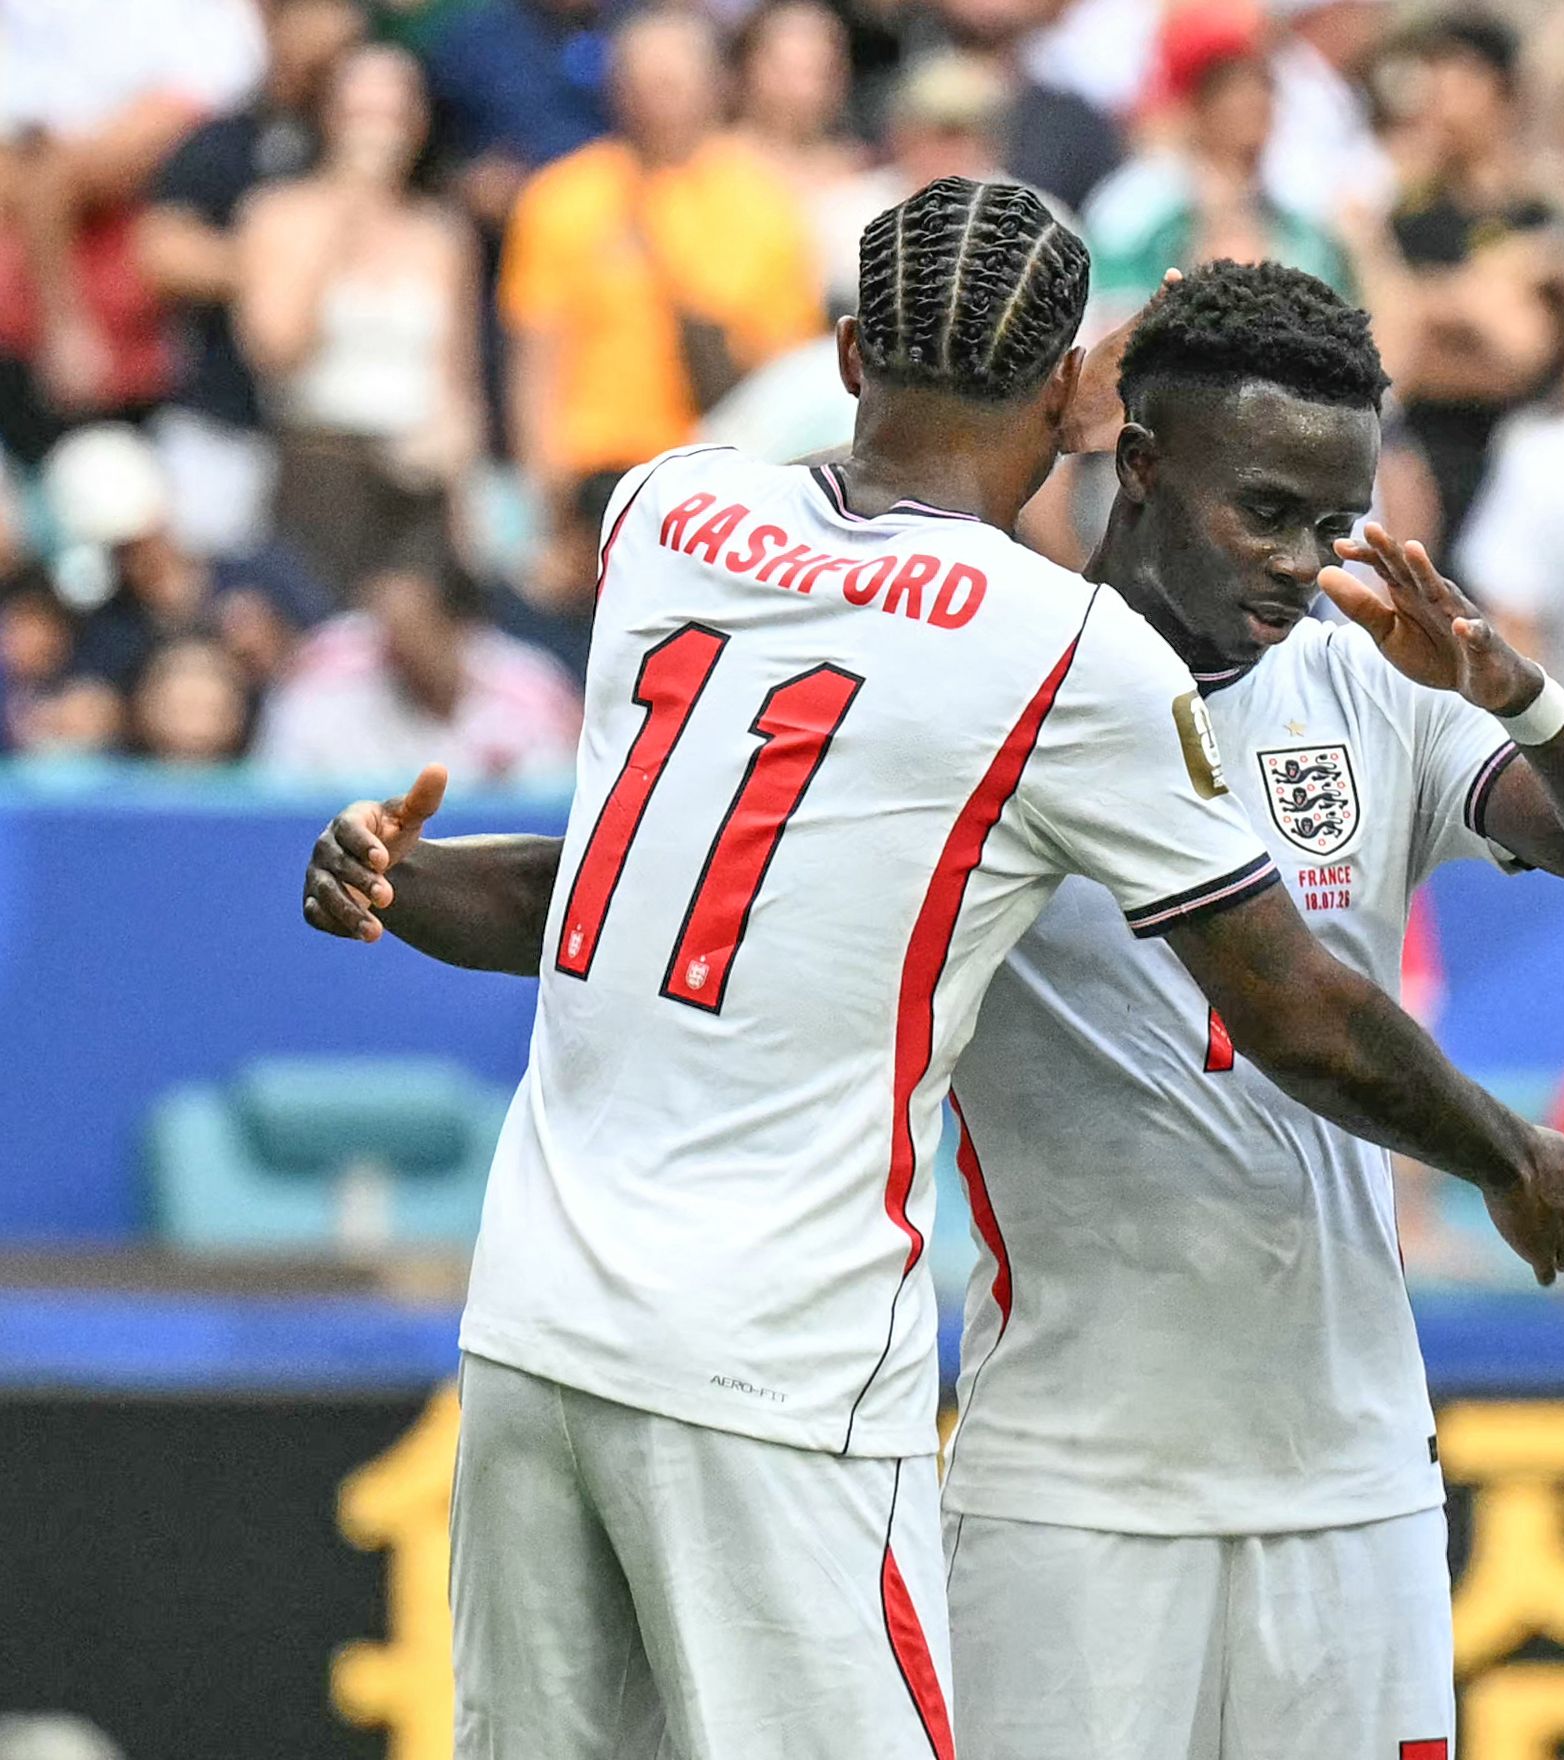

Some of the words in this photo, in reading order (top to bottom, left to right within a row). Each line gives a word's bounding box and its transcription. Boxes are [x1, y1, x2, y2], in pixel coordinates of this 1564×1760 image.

[660, 492, 987, 630] RASHFORD
[555, 620, 866, 1016] 11
[1298, 865, 1352, 888] FRANCE
[1304, 890, 1350, 911] 18.07.26
[710, 1375, 788, 1403] AERO-FIT
